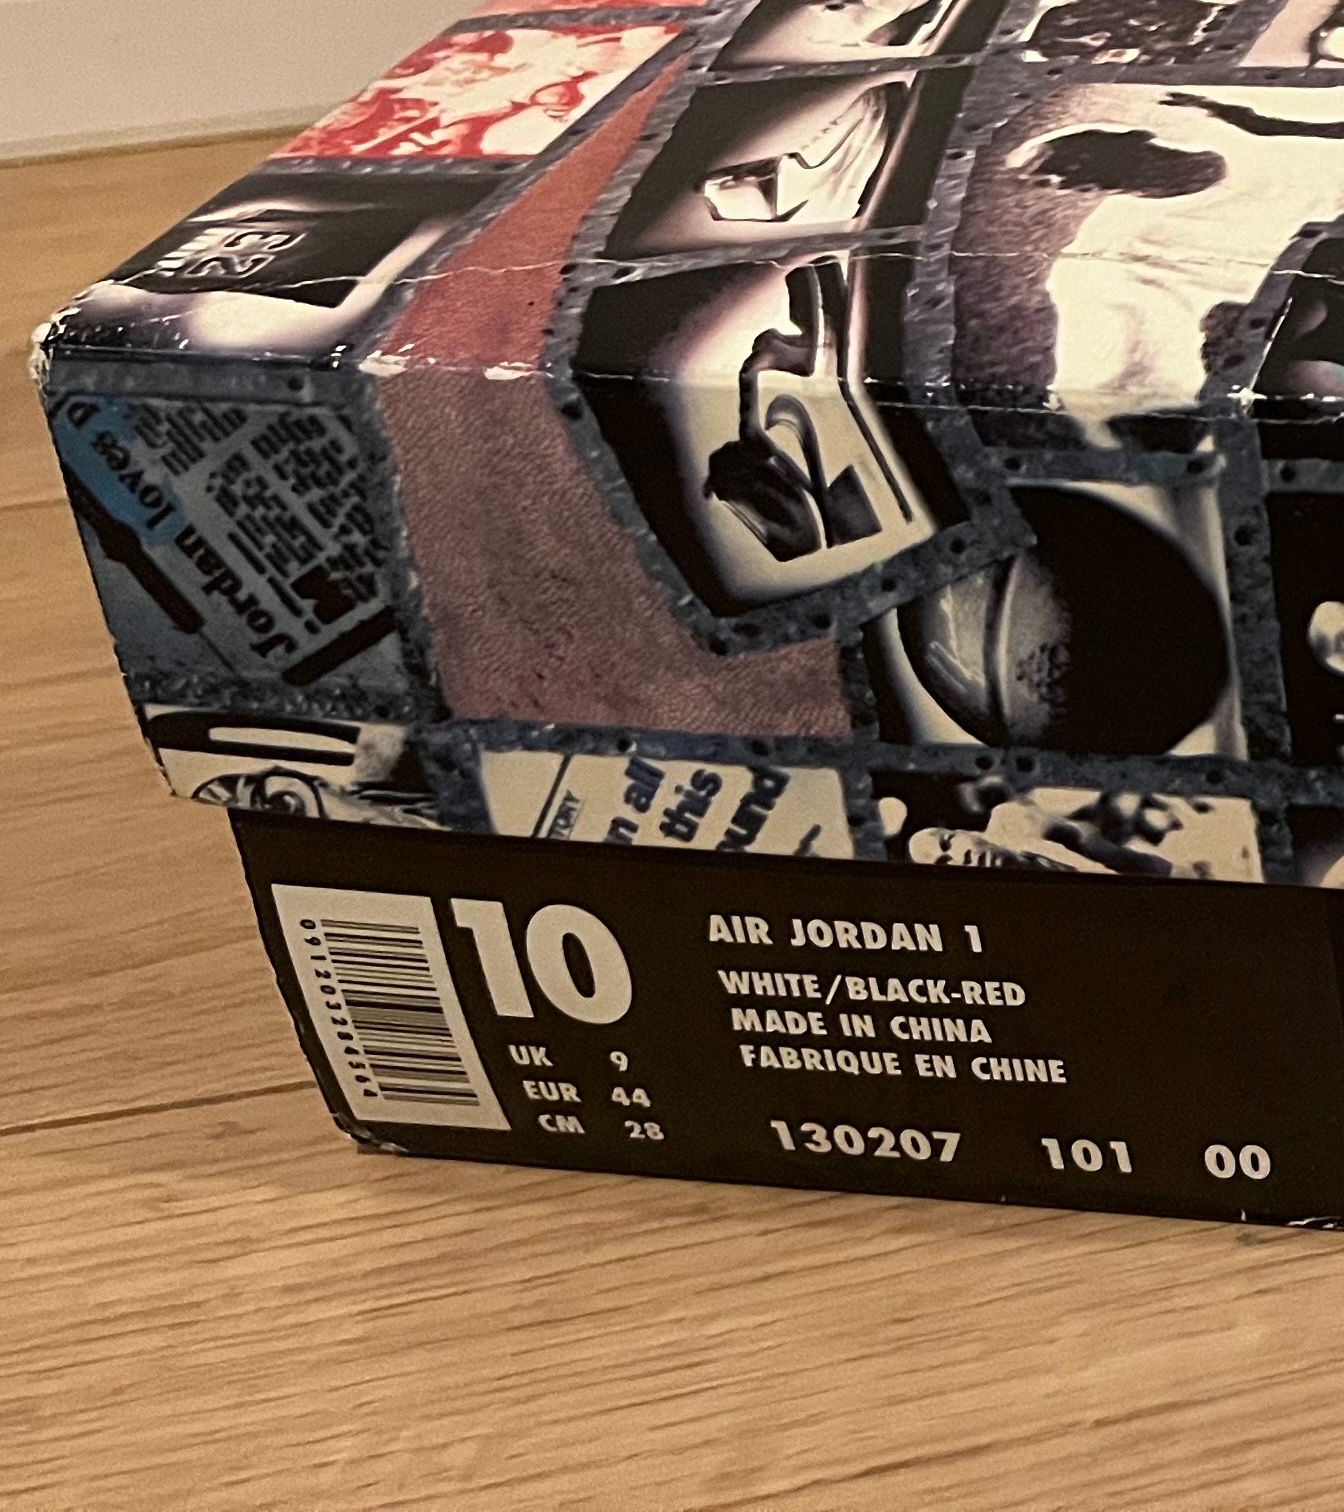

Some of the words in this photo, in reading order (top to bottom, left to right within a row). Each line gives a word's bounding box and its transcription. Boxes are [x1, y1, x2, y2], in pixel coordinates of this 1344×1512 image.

[90, 430, 178, 530] loves
[174, 524, 297, 659] Jordan
[624, 755, 665, 813] all
[659, 768, 722, 842] this
[709, 914, 773, 945] AIR
[791, 918, 943, 952] JORDAN
[964, 925, 983, 953] 1
[450, 898, 632, 1024] 10
[717, 970, 1026, 1006] WHITE/BLACK-RED
[731, 1008, 828, 1035] MADE
[839, 1013, 876, 1038] IN
[890, 1016, 993, 1044] CHINA
[508, 1045, 553, 1067] UK
[609, 1051, 629, 1072] 9
[739, 1045, 902, 1076] FABRIQUE
[914, 1054, 957, 1078] EN
[971, 1057, 1067, 1084] CHINE
[523, 1080, 581, 1103] EUR
[611, 1087, 651, 1108] 44
[537, 1114, 586, 1134] CM
[624, 1120, 665, 1142] 28
[770, 1120, 961, 1162] 130207
[1041, 1138, 1132, 1173] 101
[1204, 1144, 1271, 1180] 00
